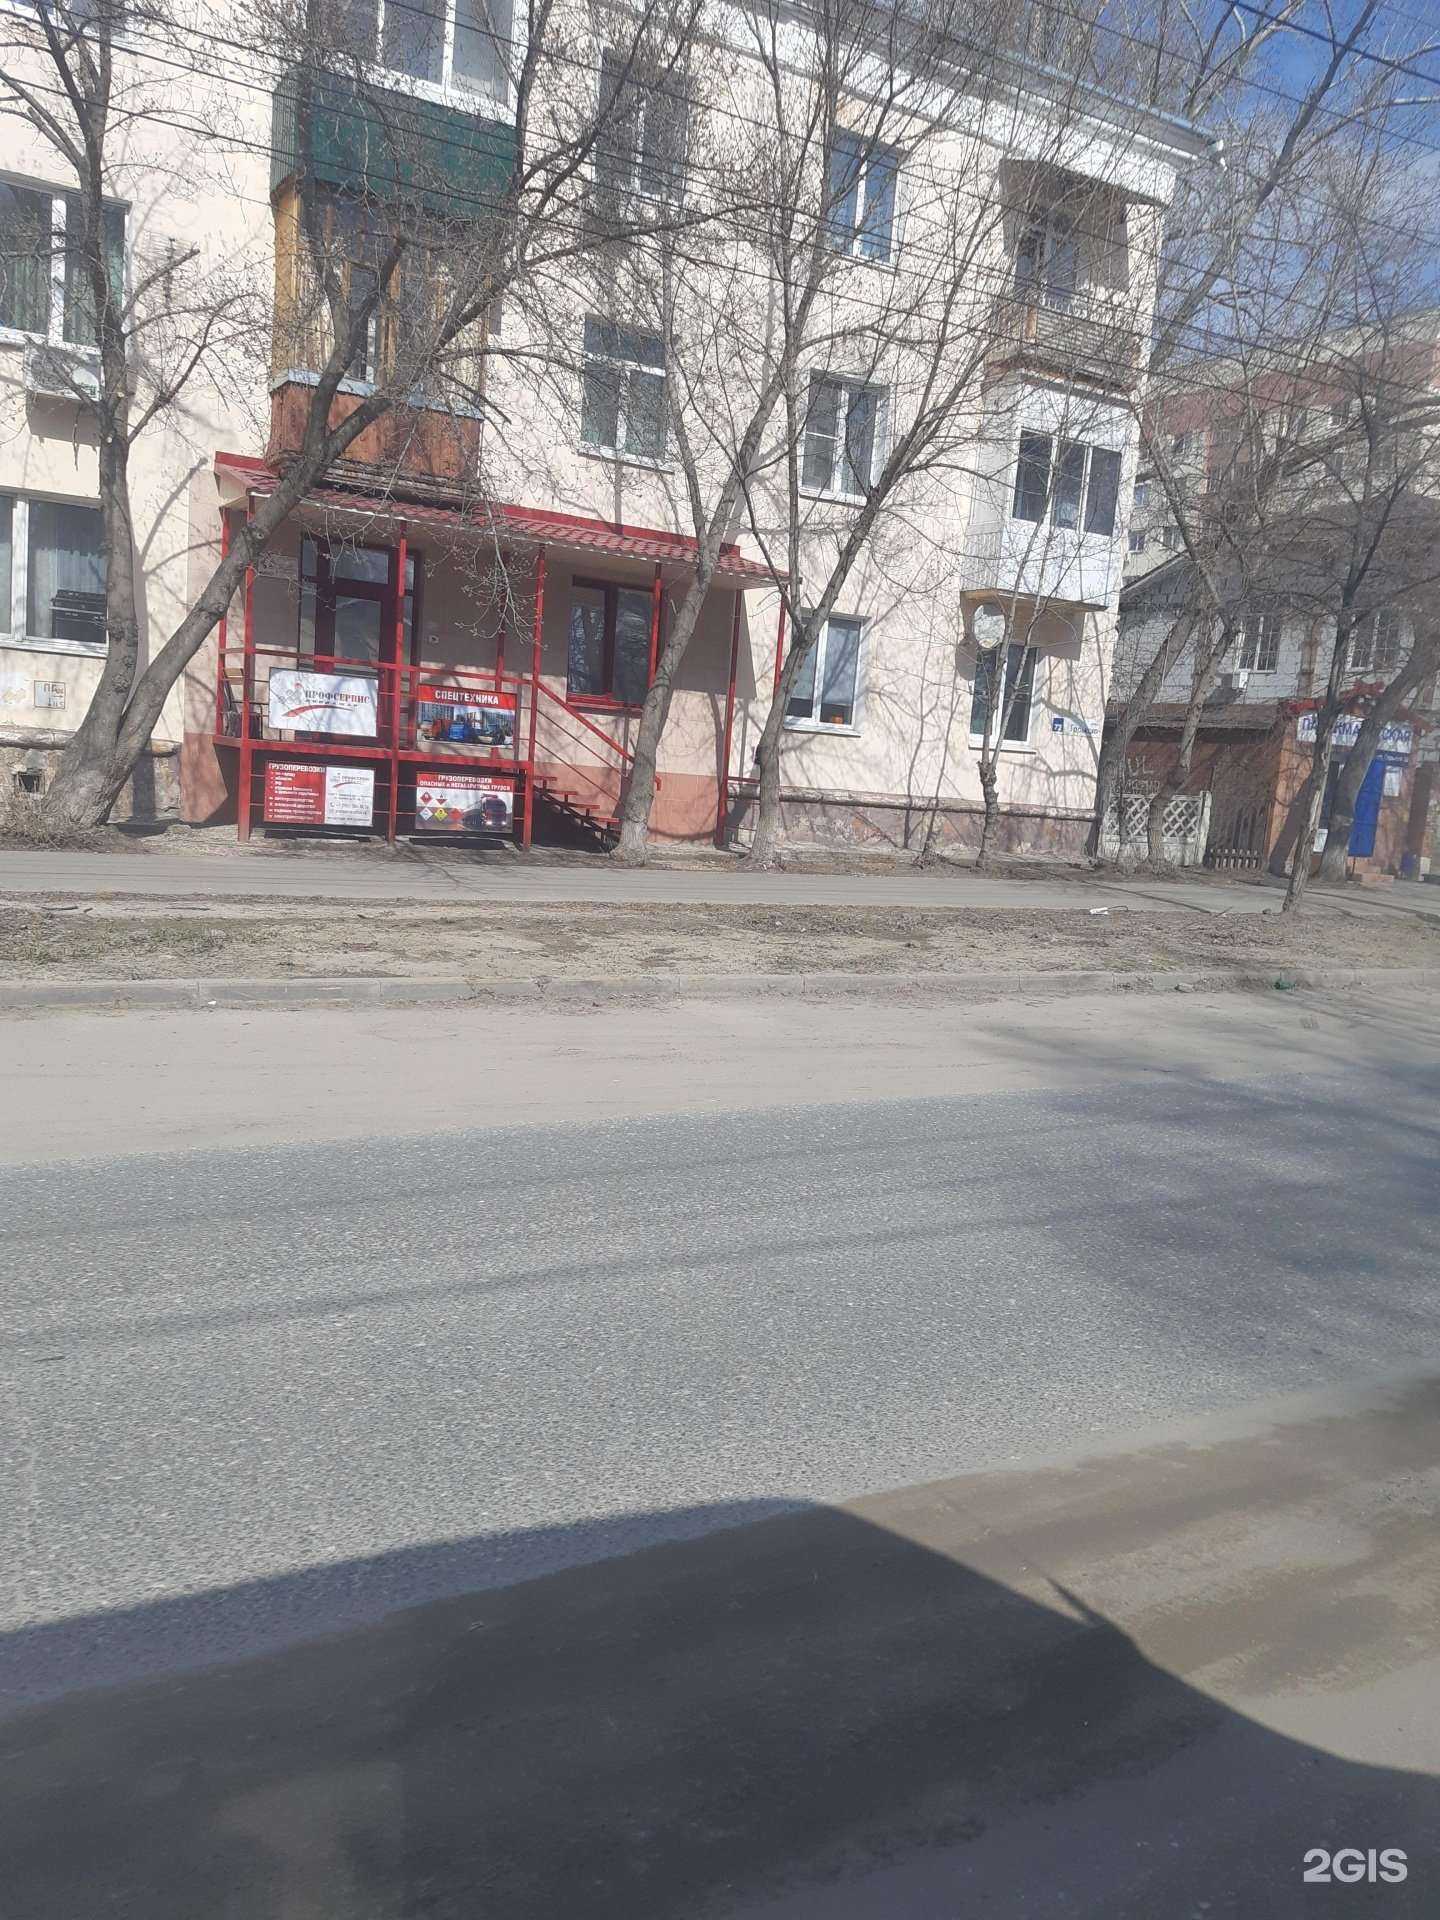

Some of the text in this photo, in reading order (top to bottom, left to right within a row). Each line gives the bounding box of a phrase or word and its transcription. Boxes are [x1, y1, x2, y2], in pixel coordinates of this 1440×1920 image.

[434, 690, 499, 705] СПЕЦТЕХНИКА
[268, 762, 326, 774] ГРУЗОПЕРЕВОЗКИ
[438, 775, 492, 784] ГРУЗОПЕРЕВОЗКИ
